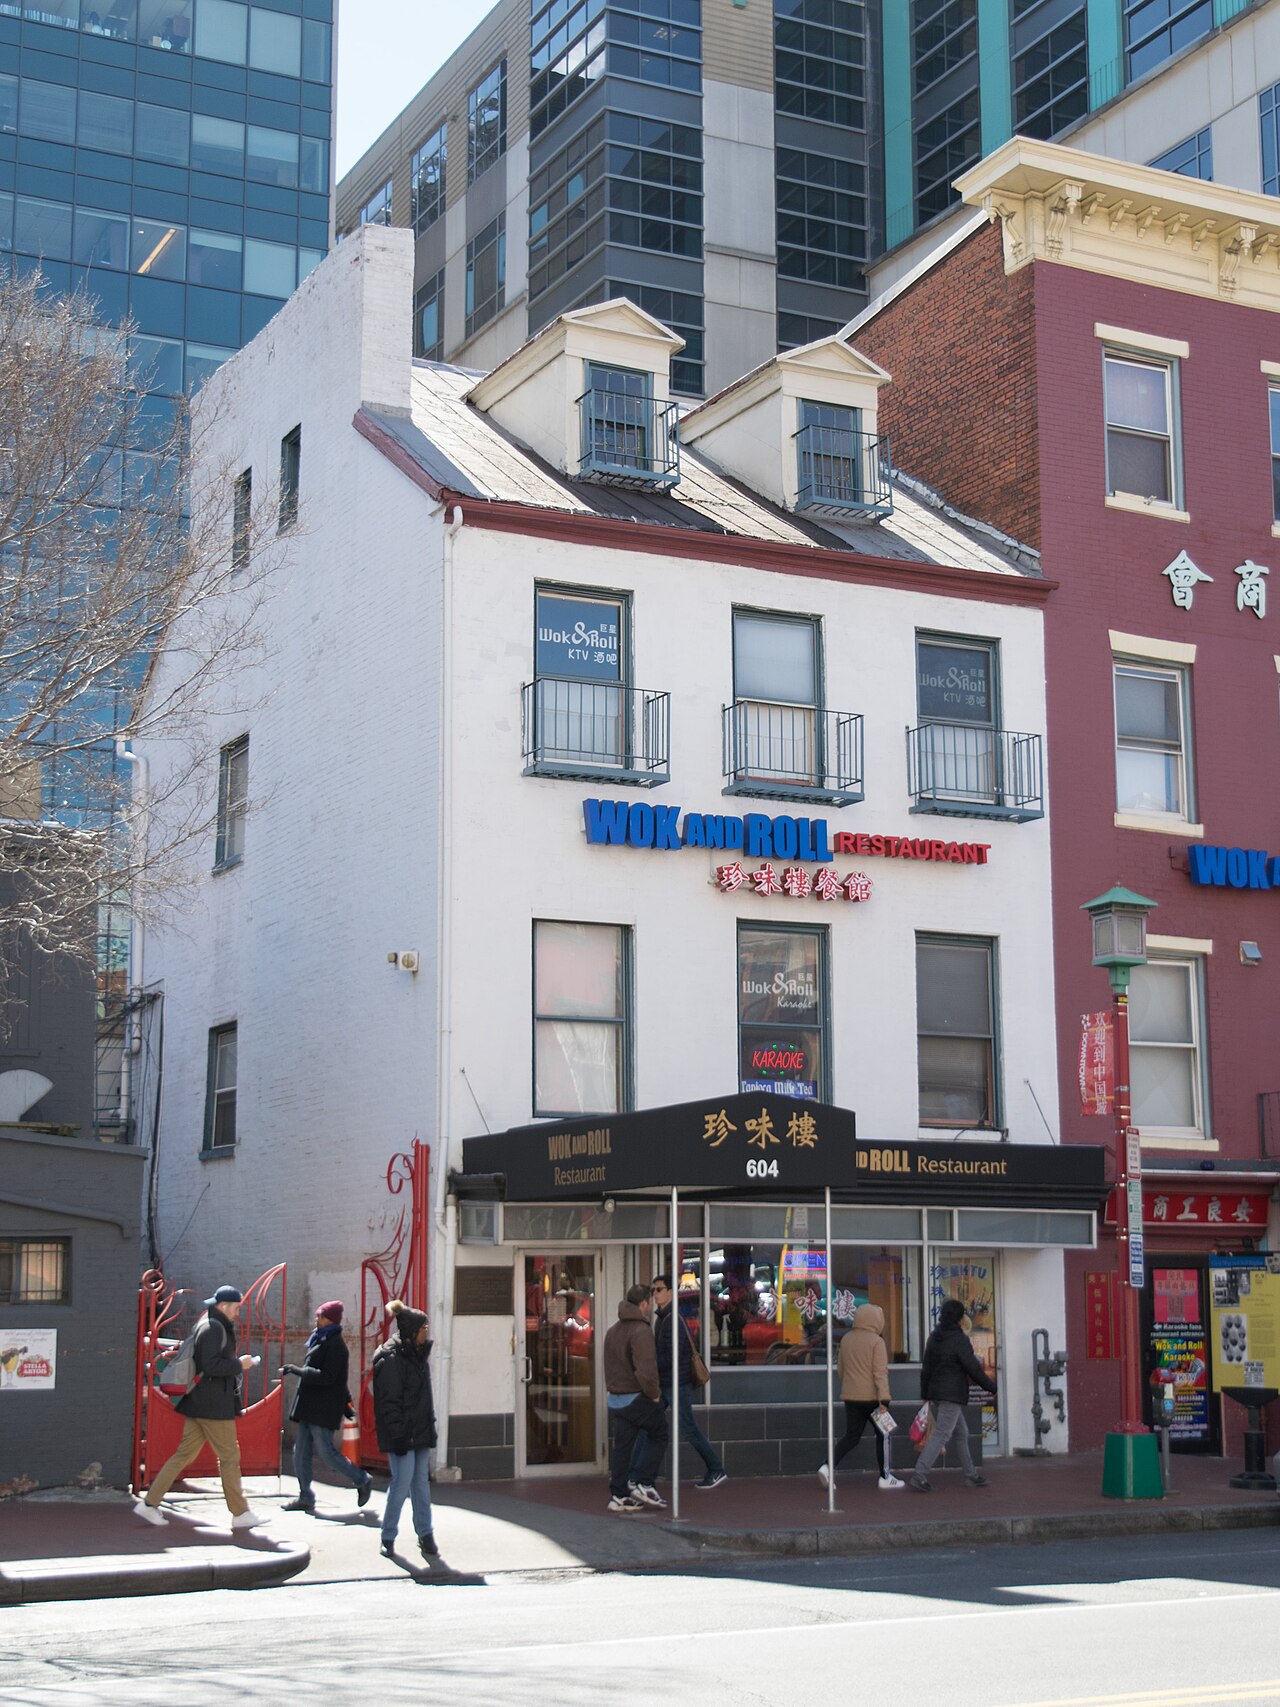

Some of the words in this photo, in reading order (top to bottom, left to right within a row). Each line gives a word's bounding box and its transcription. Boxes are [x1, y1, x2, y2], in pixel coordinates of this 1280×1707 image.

[568, 648, 589, 661] KTV
[593, 651, 617, 665] 酒吧
[943, 691, 961, 703] KTV
[583, 798, 681, 850] WOK
[683, 813, 743, 849] AND
[743, 812, 833, 862] ROLL
[834, 831, 992, 865] RESTAURANT
[1188, 844, 1270, 890] WOK
[716, 861, 873, 902] 珍味樓餐館
[777, 996, 812, 1008] Karaoke
[752, 1050, 804, 1069] KARAOKE
[797, 1083, 813, 1095] Tea
[702, 1107, 818, 1149] 珍味樓
[548, 1134, 571, 1160] WOK
[572, 1135, 587, 1155] AND
[587, 1128, 612, 1156] ROLL
[746, 1159, 779, 1177] 604
[869, 1149, 911, 1172] ROLL
[917, 1155, 1007, 1175] Restaurant
[554, 1166, 606, 1185] Restaurant
[784, 1253, 826, 1268] OPEN
[1155, 1341, 1171, 1350] Wok
[1176, 1341, 1187, 1350] and
[1188, 1341, 1203, 1350] Roll
[1164, 1352, 1195, 1361] Karaoke
